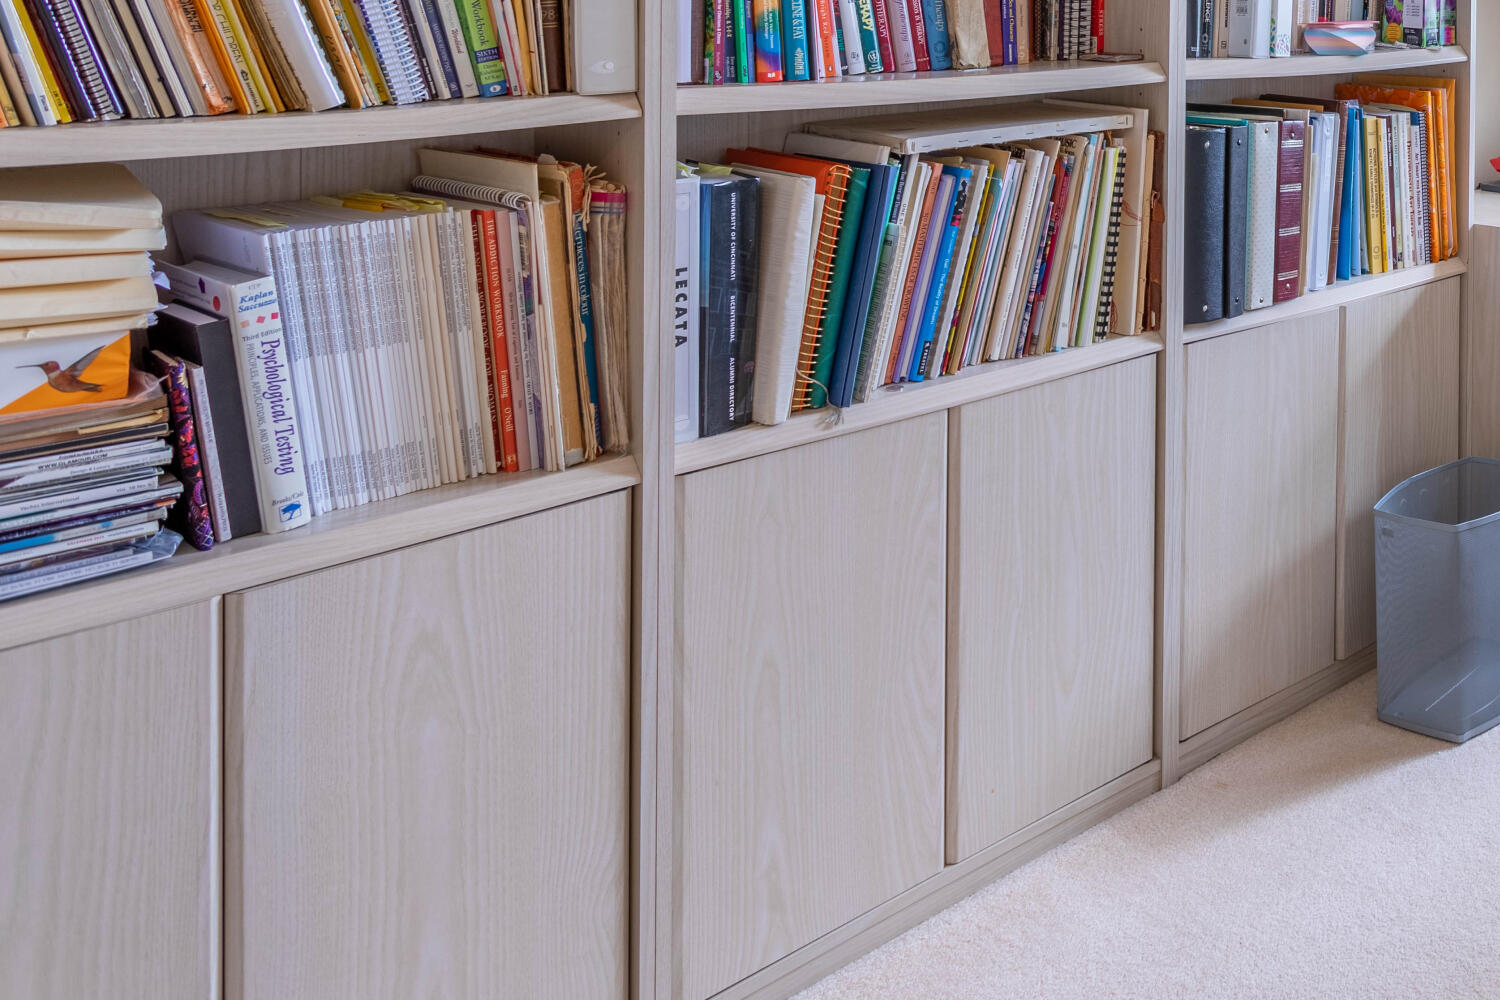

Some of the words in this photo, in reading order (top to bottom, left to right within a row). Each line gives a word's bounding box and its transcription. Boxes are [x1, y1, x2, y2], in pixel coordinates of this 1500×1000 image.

[471, 0, 491, 46] Workbook
[240, 289, 274, 304] Kaplan
[487, 239, 499, 287] ADDICTION
[493, 288, 505, 338] WORKBOOK
[675, 266, 688, 347] LECATA
[257, 338, 291, 424] Psychological
[273, 424, 296, 476] Testing
